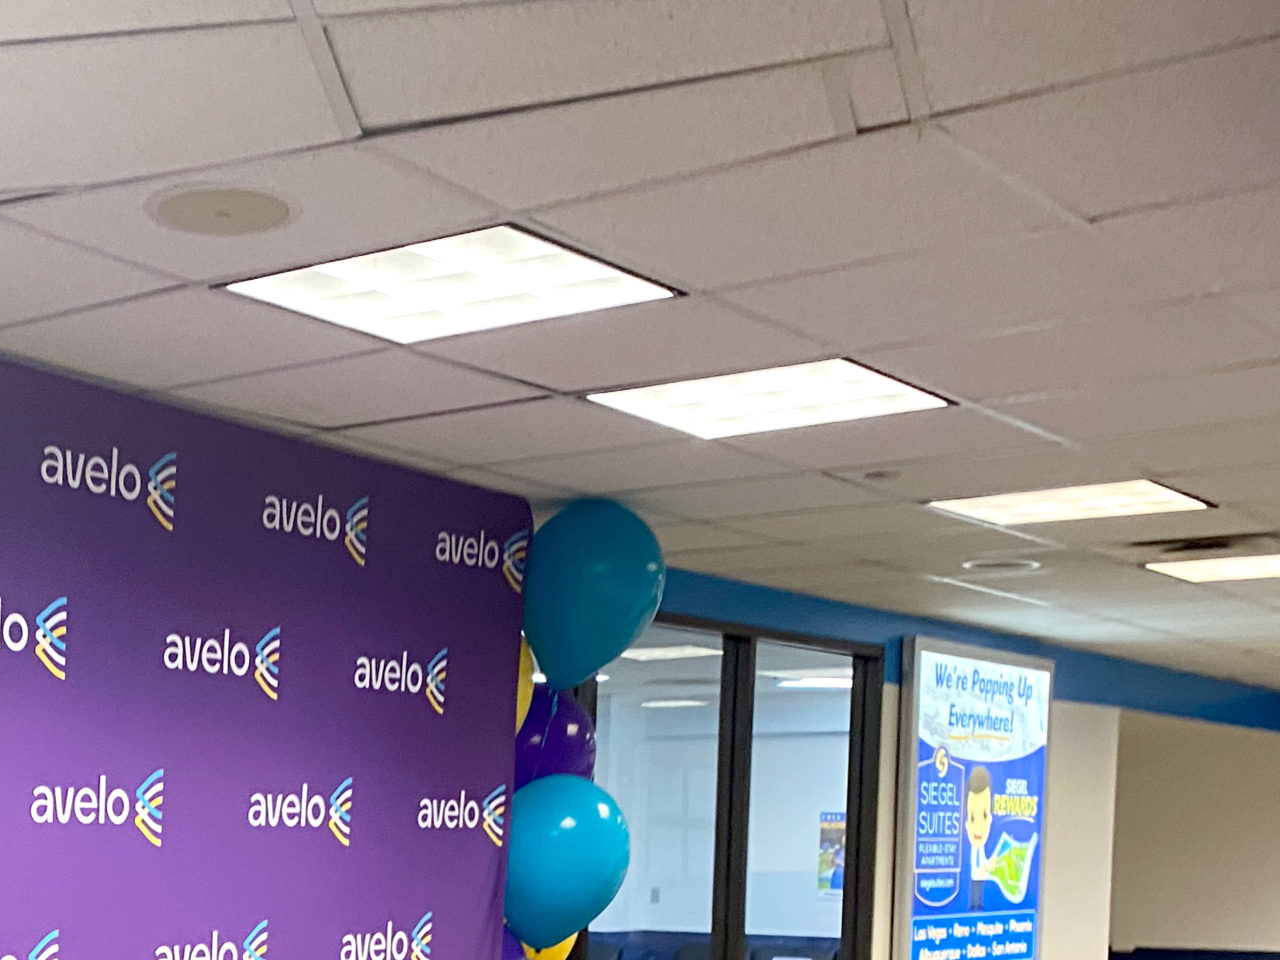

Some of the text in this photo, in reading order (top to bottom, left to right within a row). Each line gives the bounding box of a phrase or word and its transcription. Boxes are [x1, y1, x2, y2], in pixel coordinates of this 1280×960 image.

[40, 446, 141, 501] avelo
[262, 494, 341, 541] avelo
[435, 530, 499, 568] avelo
[163, 628, 250, 677] avelo
[354, 650, 423, 693] avelo
[935, 662, 1033, 707] We're Popping Up
[948, 704, 1015, 736] Everywhere!
[30, 774, 130, 825] avelo
[247, 783, 326, 828] avelo
[920, 781, 960, 806] SIEGEL
[994, 794, 1038, 817] REWARDS
[1005, 778, 1028, 795] SIEGEL
[417, 790, 480, 829] avelo
[919, 811, 960, 835] SUITES
